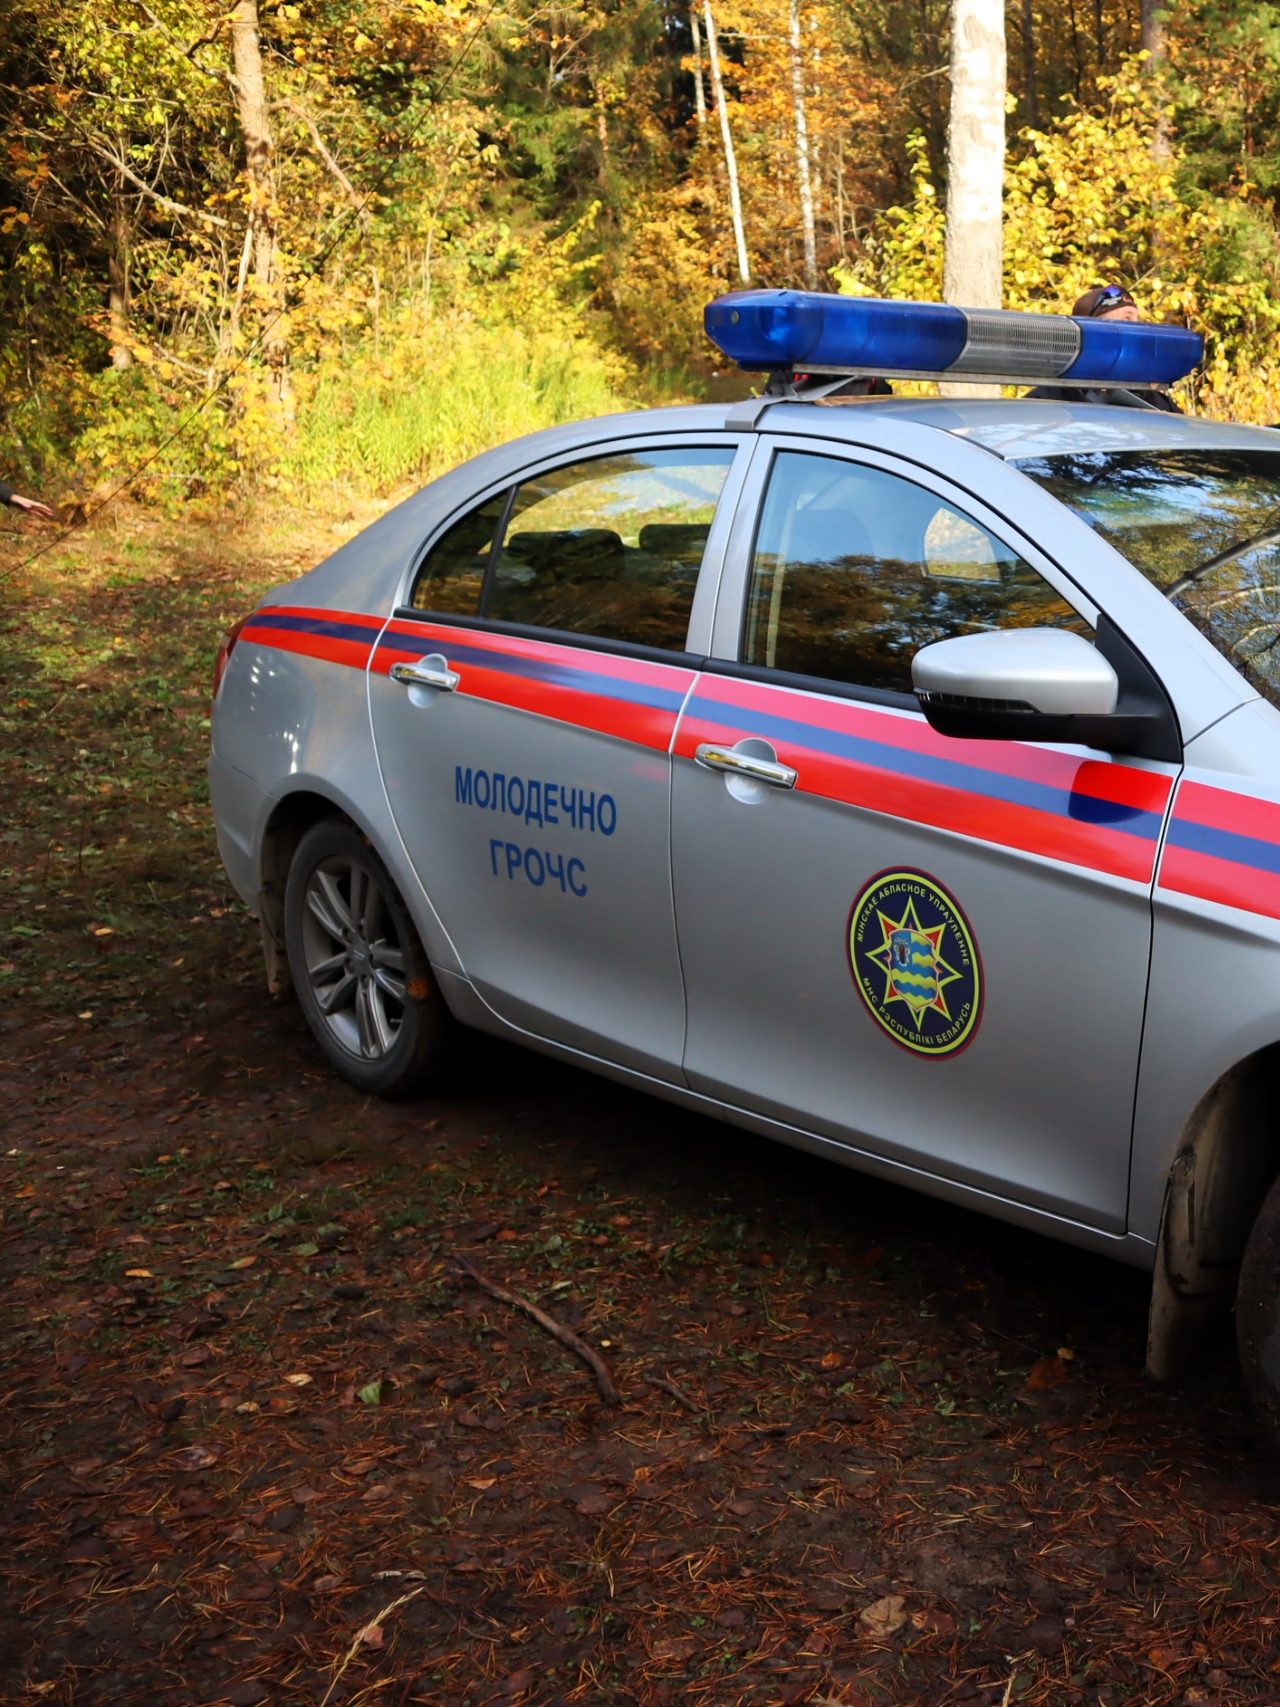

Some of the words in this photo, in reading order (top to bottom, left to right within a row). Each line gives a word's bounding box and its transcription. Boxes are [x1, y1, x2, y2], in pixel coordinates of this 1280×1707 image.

[455, 766, 616, 836] МОЛОДЕЧНО
[489, 838, 588, 897] ГРОЧС
[878, 883, 927, 900] АБЛАСНОЕ
[935, 1002, 971, 1044] БЕЛАРУСЬ
